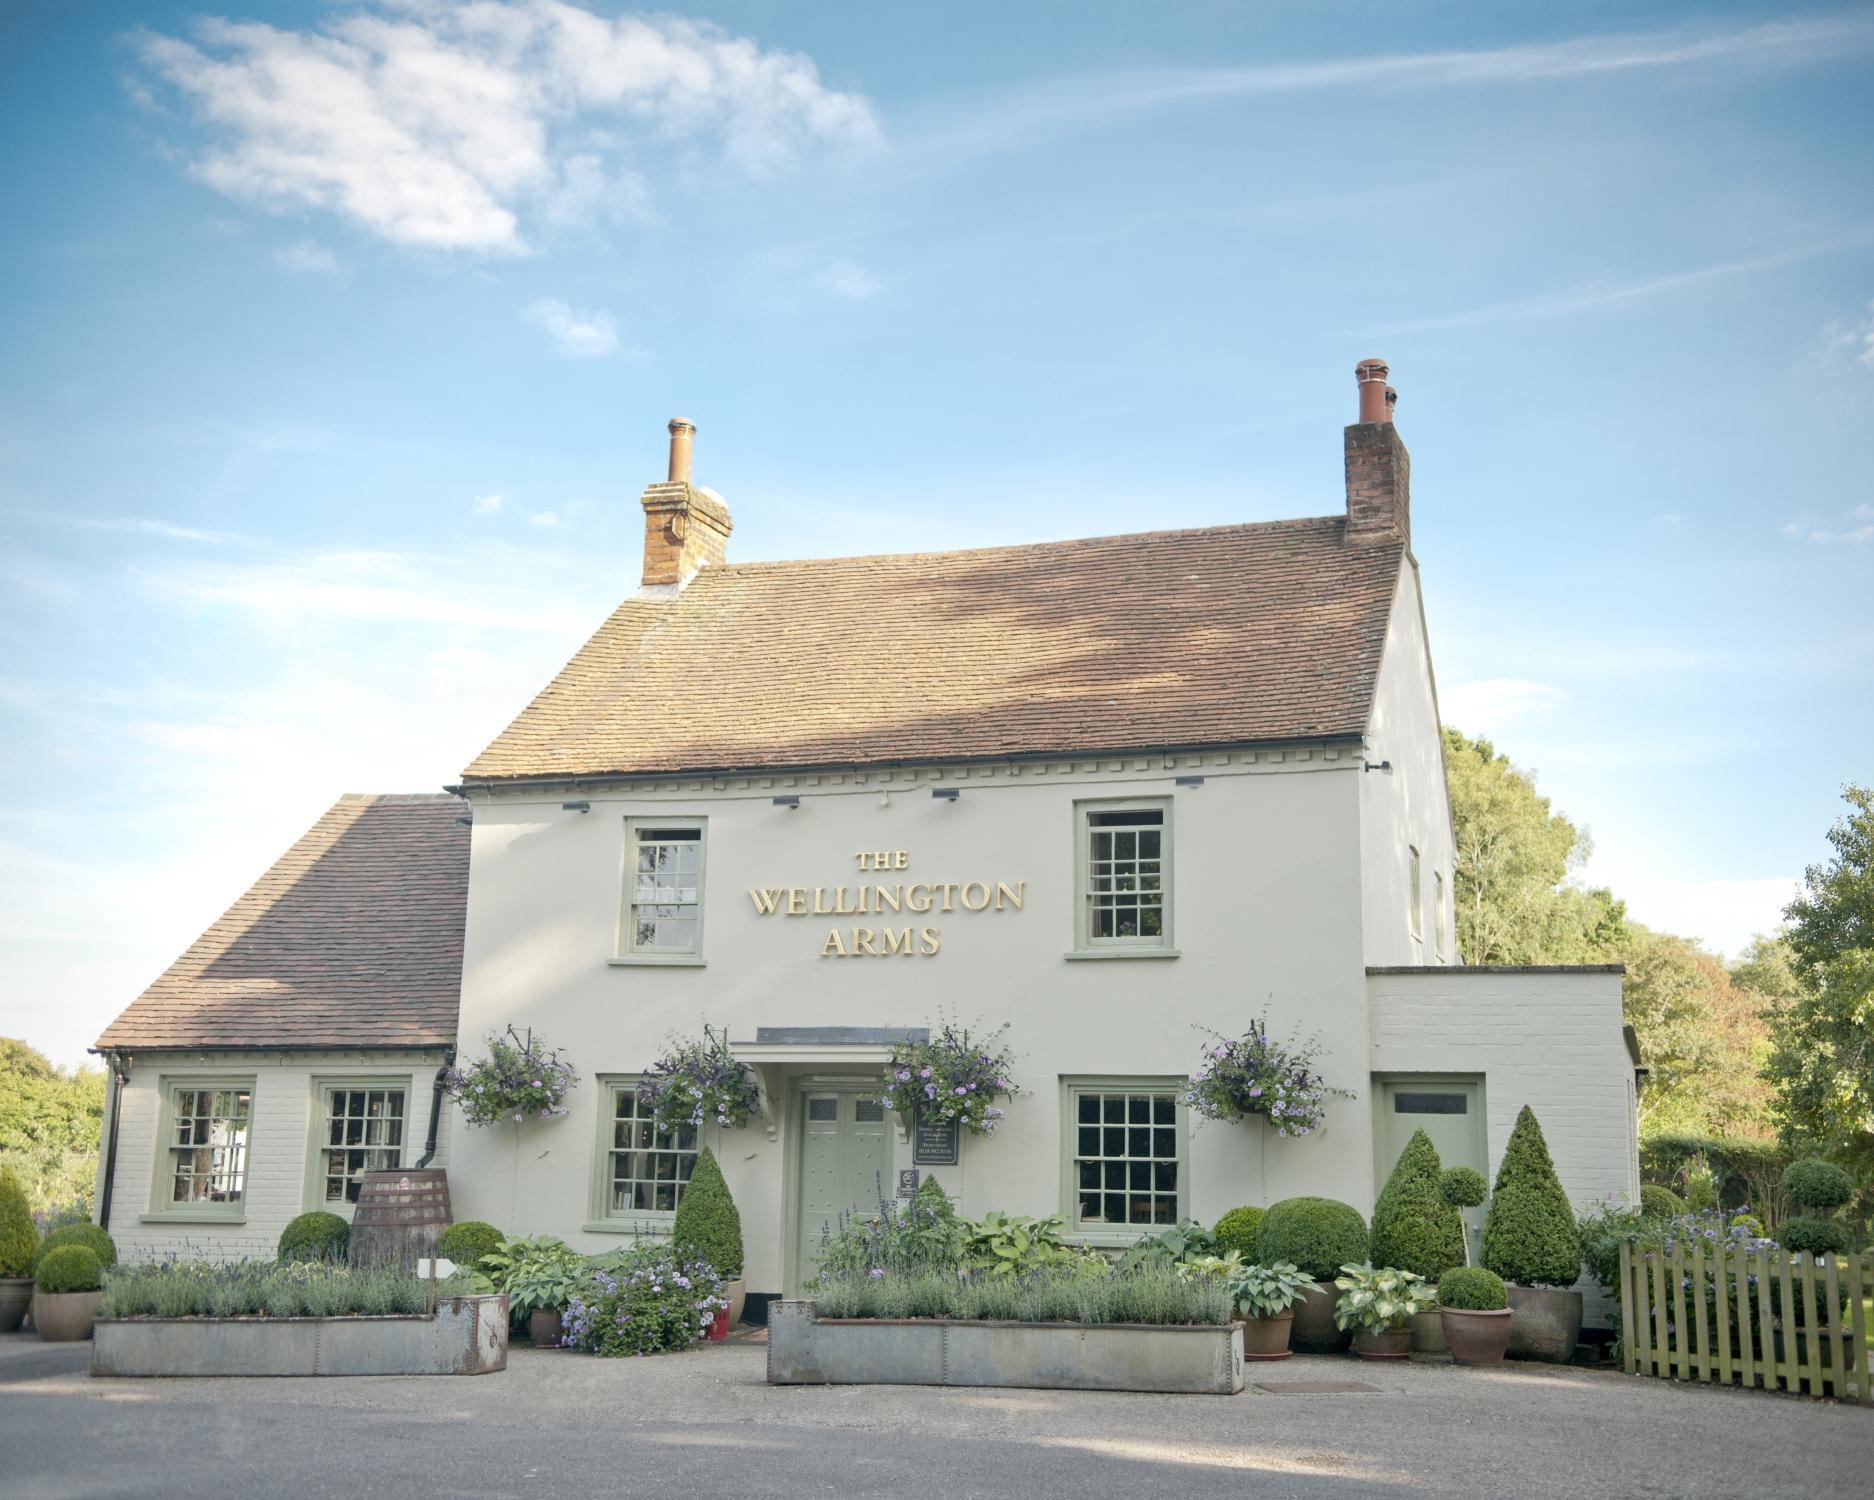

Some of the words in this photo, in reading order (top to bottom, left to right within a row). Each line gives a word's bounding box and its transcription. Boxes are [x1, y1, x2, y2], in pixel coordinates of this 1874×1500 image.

[855, 850, 909, 872] THE
[747, 881, 1027, 916] WELLINGTON
[820, 927, 941, 958] ARMS
